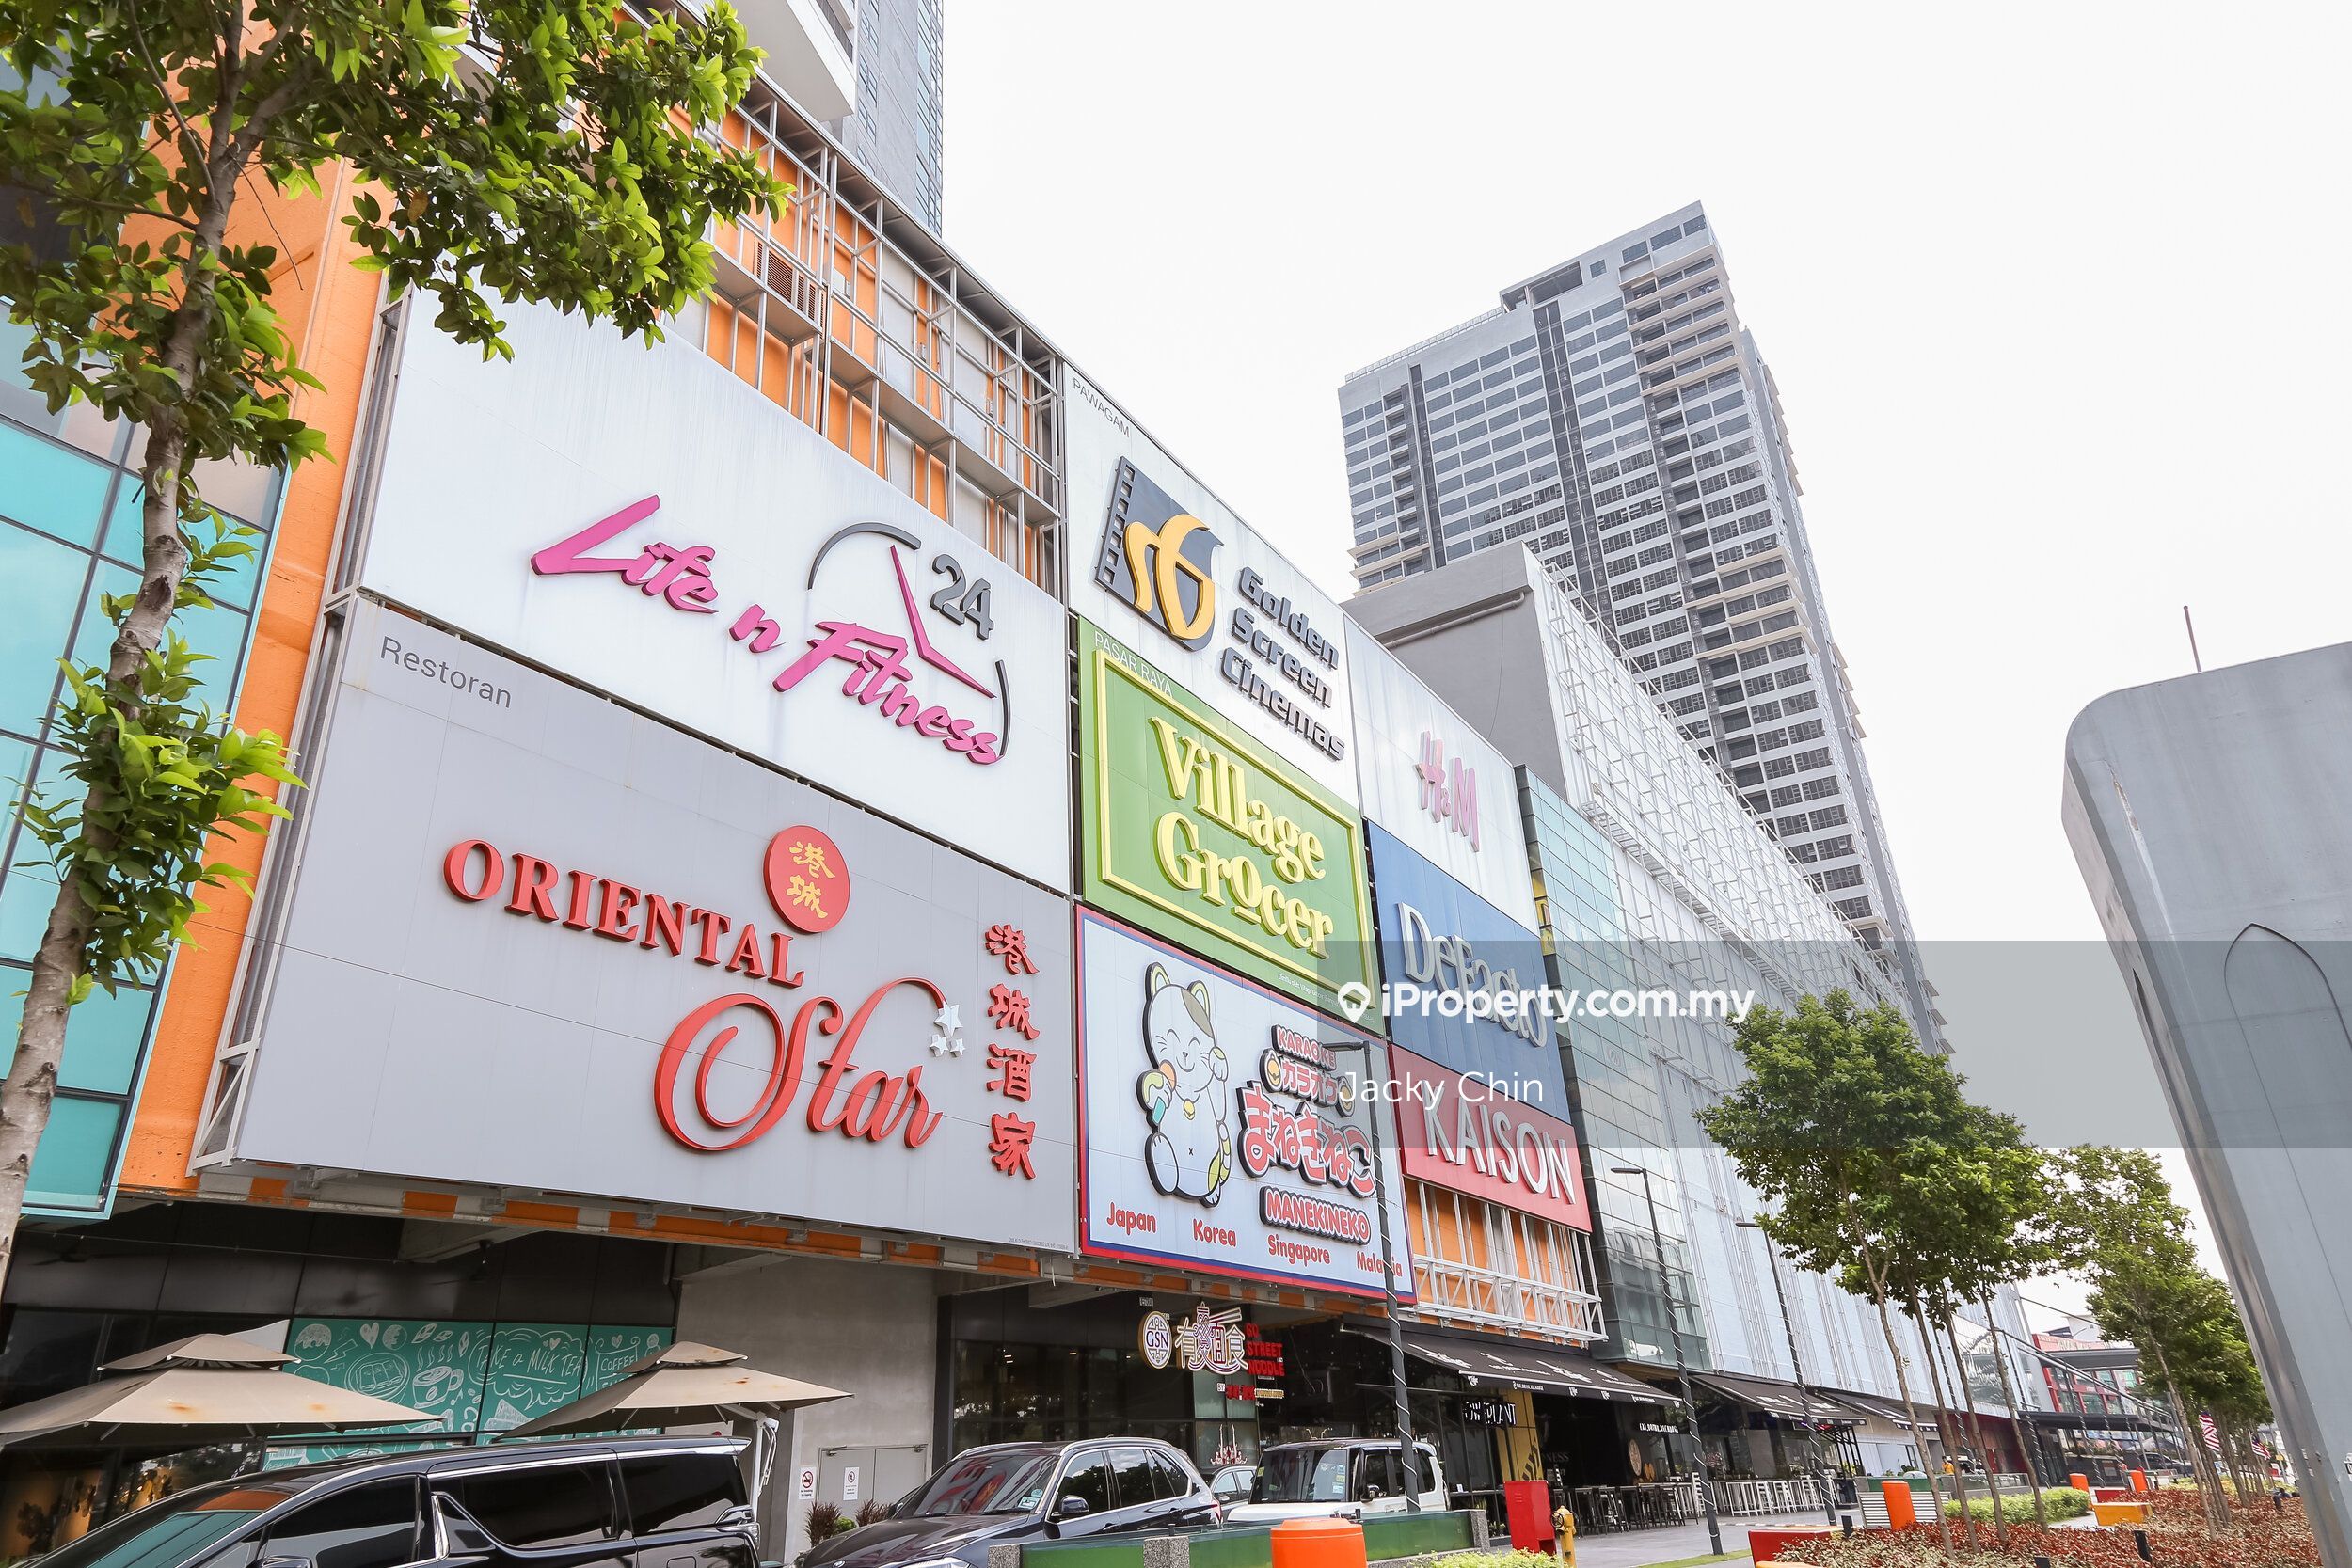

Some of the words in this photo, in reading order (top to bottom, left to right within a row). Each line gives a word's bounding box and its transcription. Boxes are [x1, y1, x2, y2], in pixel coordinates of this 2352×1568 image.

[1073, 377, 1131, 438] PAWAGAM
[930, 554, 995, 641] 24
[1236, 566, 1340, 670] Golden
[380, 636, 512, 710] Restoran
[729, 604, 785, 653] n
[771, 620, 1003, 765] Fitness
[1094, 631, 1138, 675] PASAR
[1141, 664, 1172, 698] RAYA
[1231, 607, 1333, 708] Screen
[1220, 646, 1345, 761] Cinemas
[1148, 716, 1327, 884] Village
[1414, 730, 1480, 852] H&M
[443, 839, 804, 988] ORIENTAL
[1153, 812, 1334, 959] Grocer
[653, 976, 946, 1153] Star
[1276, 1026, 1337, 1071] KARAOKE
[1242, 1082, 1376, 1197] まねきねこ
[1422, 1080, 1579, 1205] KAISON
[1107, 1202, 1156, 1236] Japan
[1193, 1219, 1236, 1248] Korea
[1267, 1234, 1331, 1267] Singapore
[1357, 1251, 1403, 1277] Malaia
[1266, 1189, 1371, 1243] MANEKINEKO
[527, 1347, 559, 1373] MILK
[560, 1353, 582, 1377] TEA
[600, 1354, 636, 1372] COFFEE
[1146, 1330, 1168, 1349] GSN
[1246, 1340, 1283, 1358] STREET
[1247, 1359, 1286, 1377] NOODLE
